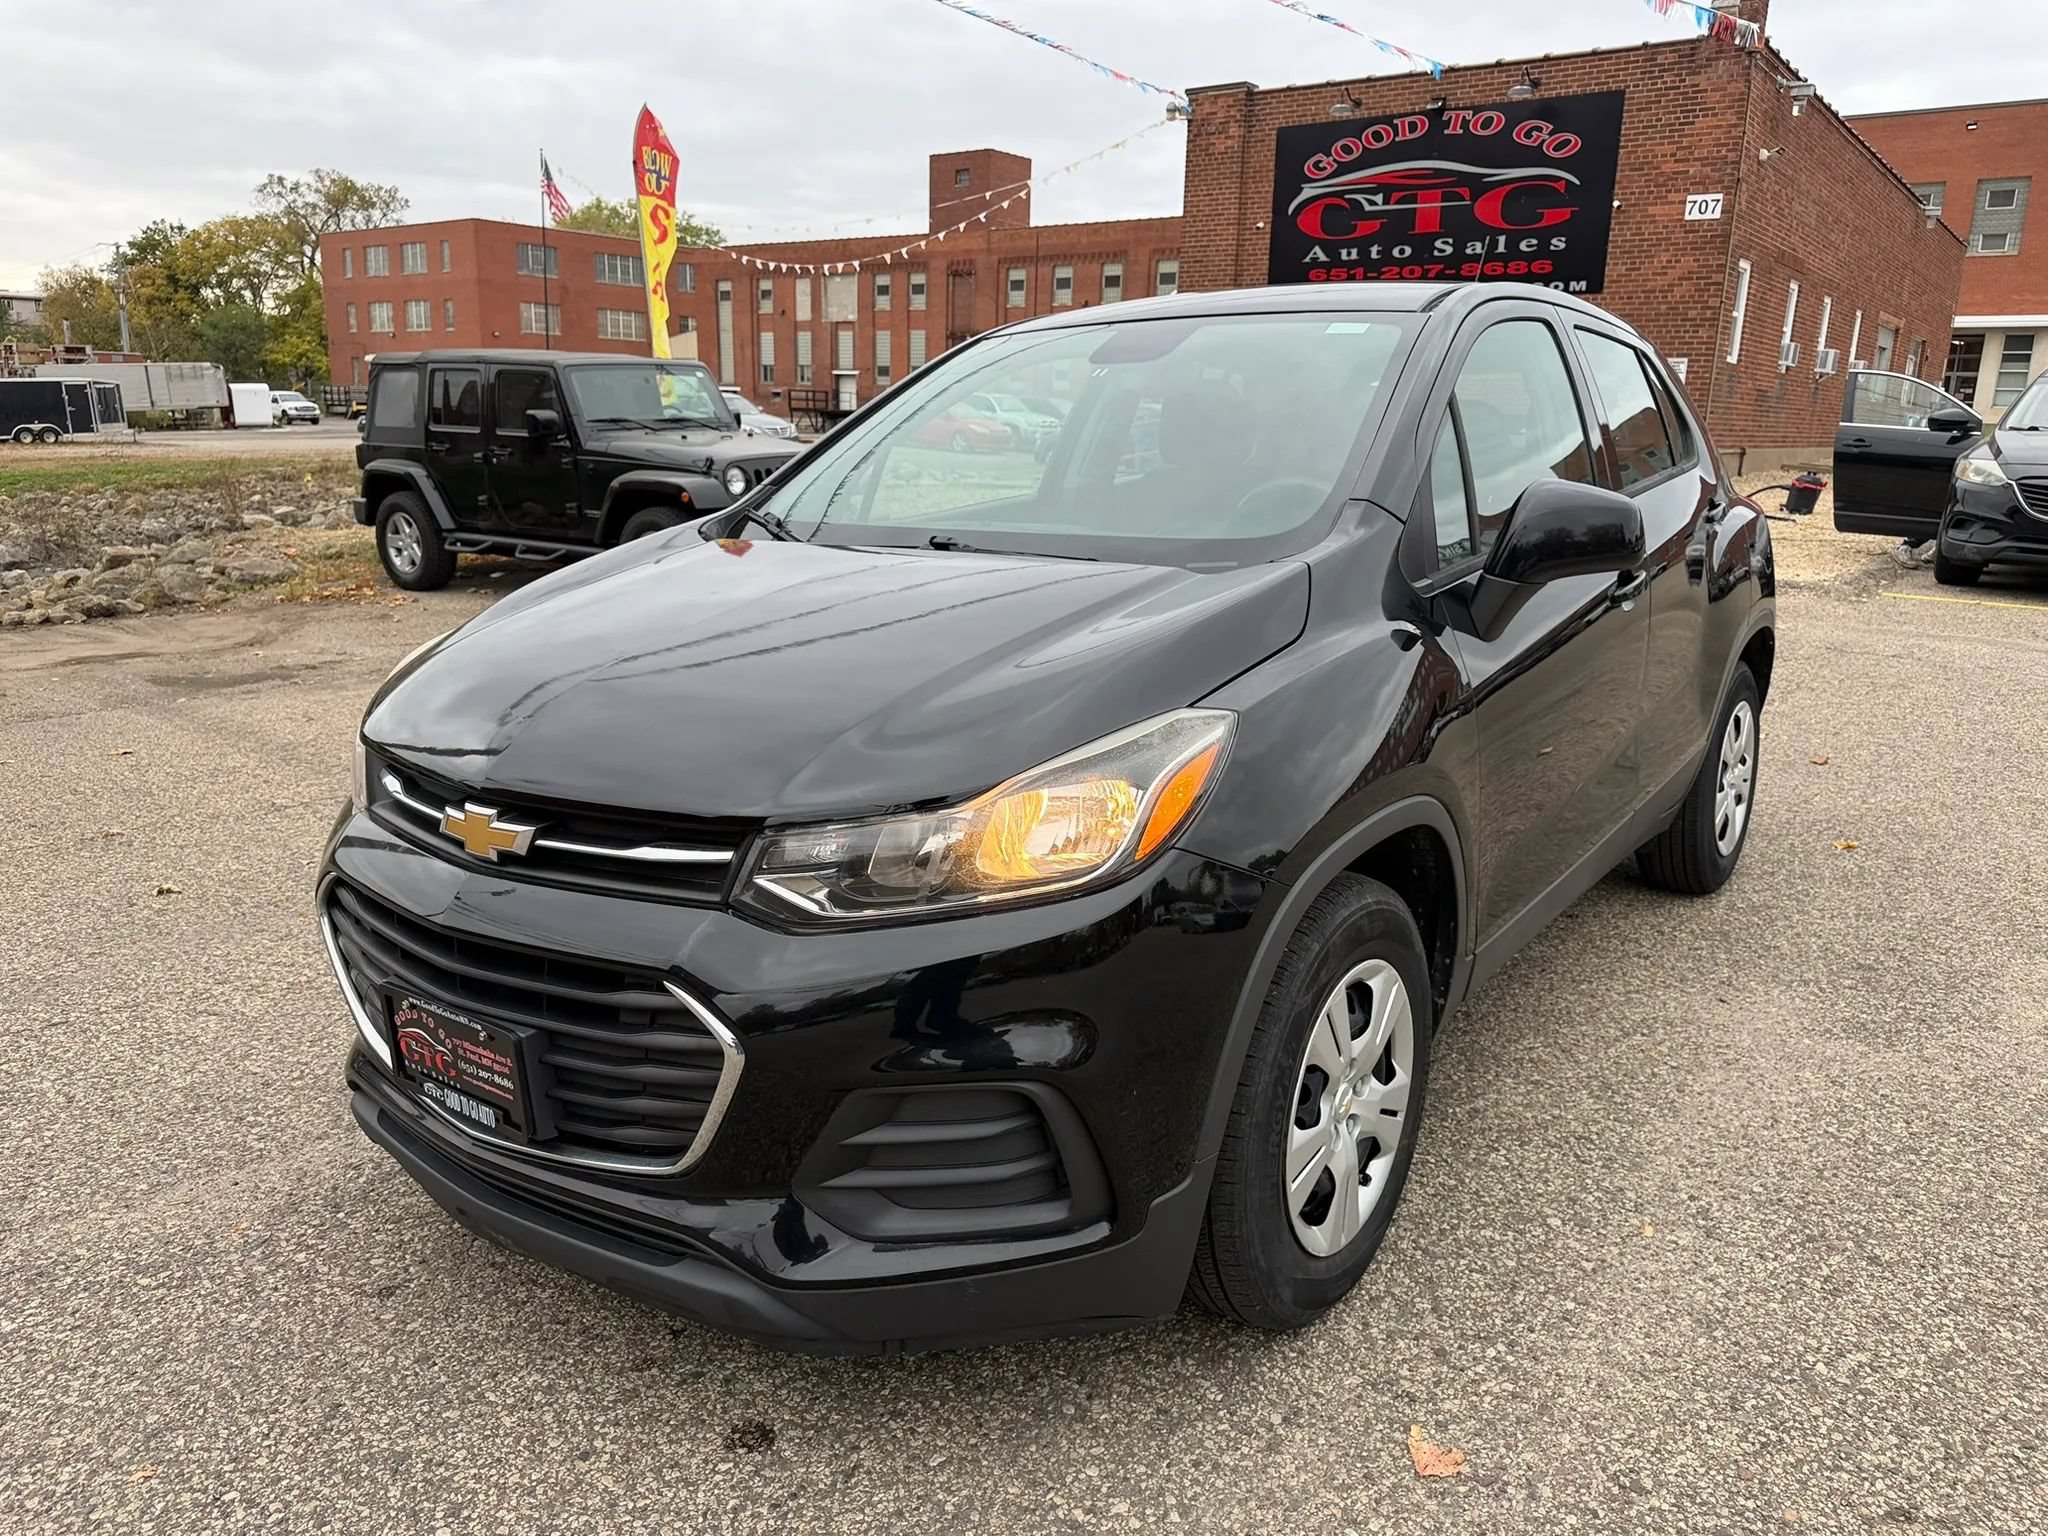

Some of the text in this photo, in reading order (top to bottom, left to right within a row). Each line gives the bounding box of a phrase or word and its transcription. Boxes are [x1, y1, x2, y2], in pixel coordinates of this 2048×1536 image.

[1303, 110, 1582, 179] GOOD TO GO
[1296, 179, 1580, 240] GTG
[1687, 198, 1721, 216] 707
[1301, 233, 1568, 264] Auto Sales
[1307, 259, 1554, 282] 651-207-8686
[394, 1008, 418, 1026] GOOD
[420, 1012, 435, 1029] TO
[477, 1068, 514, 1090] 207-8686
